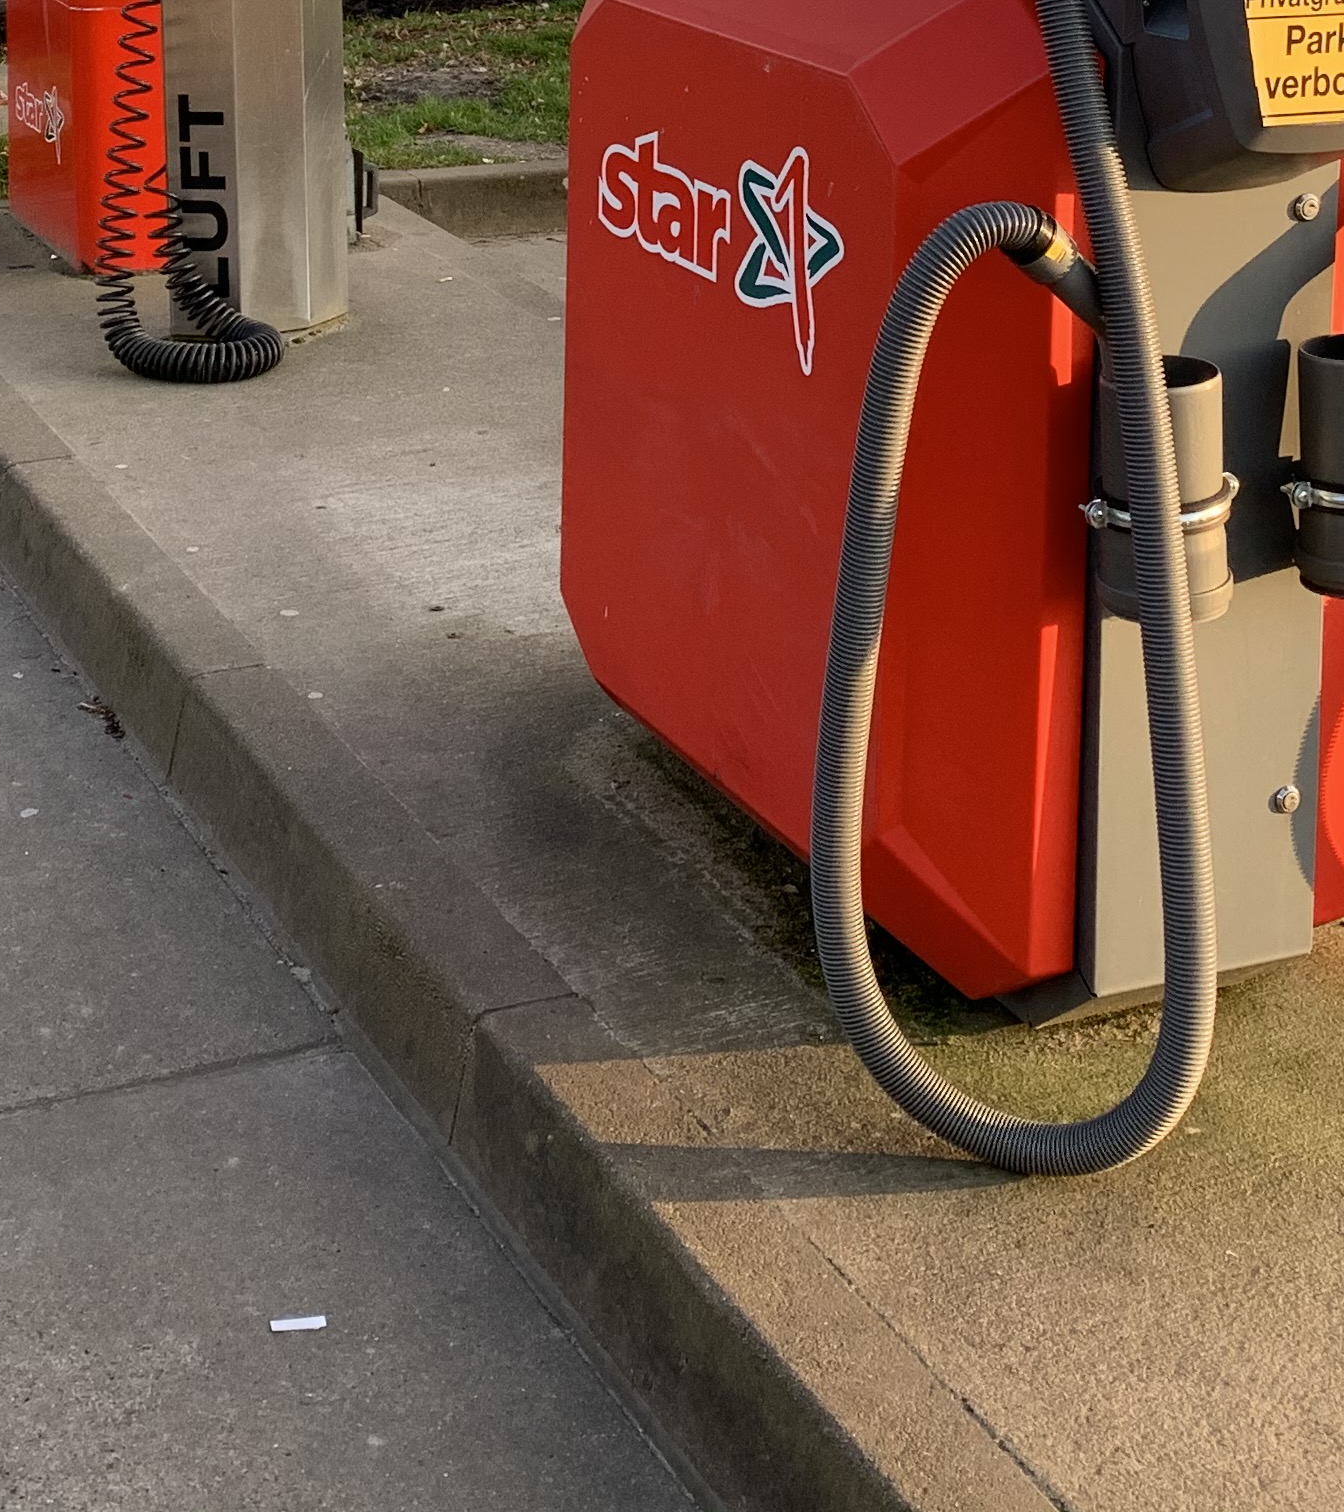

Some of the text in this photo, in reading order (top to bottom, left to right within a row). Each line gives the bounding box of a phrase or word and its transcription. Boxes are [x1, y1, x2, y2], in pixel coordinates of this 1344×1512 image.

[14, 81, 44, 133] star
[177, 94, 230, 298] LUFT
[598, 130, 732, 283] star
